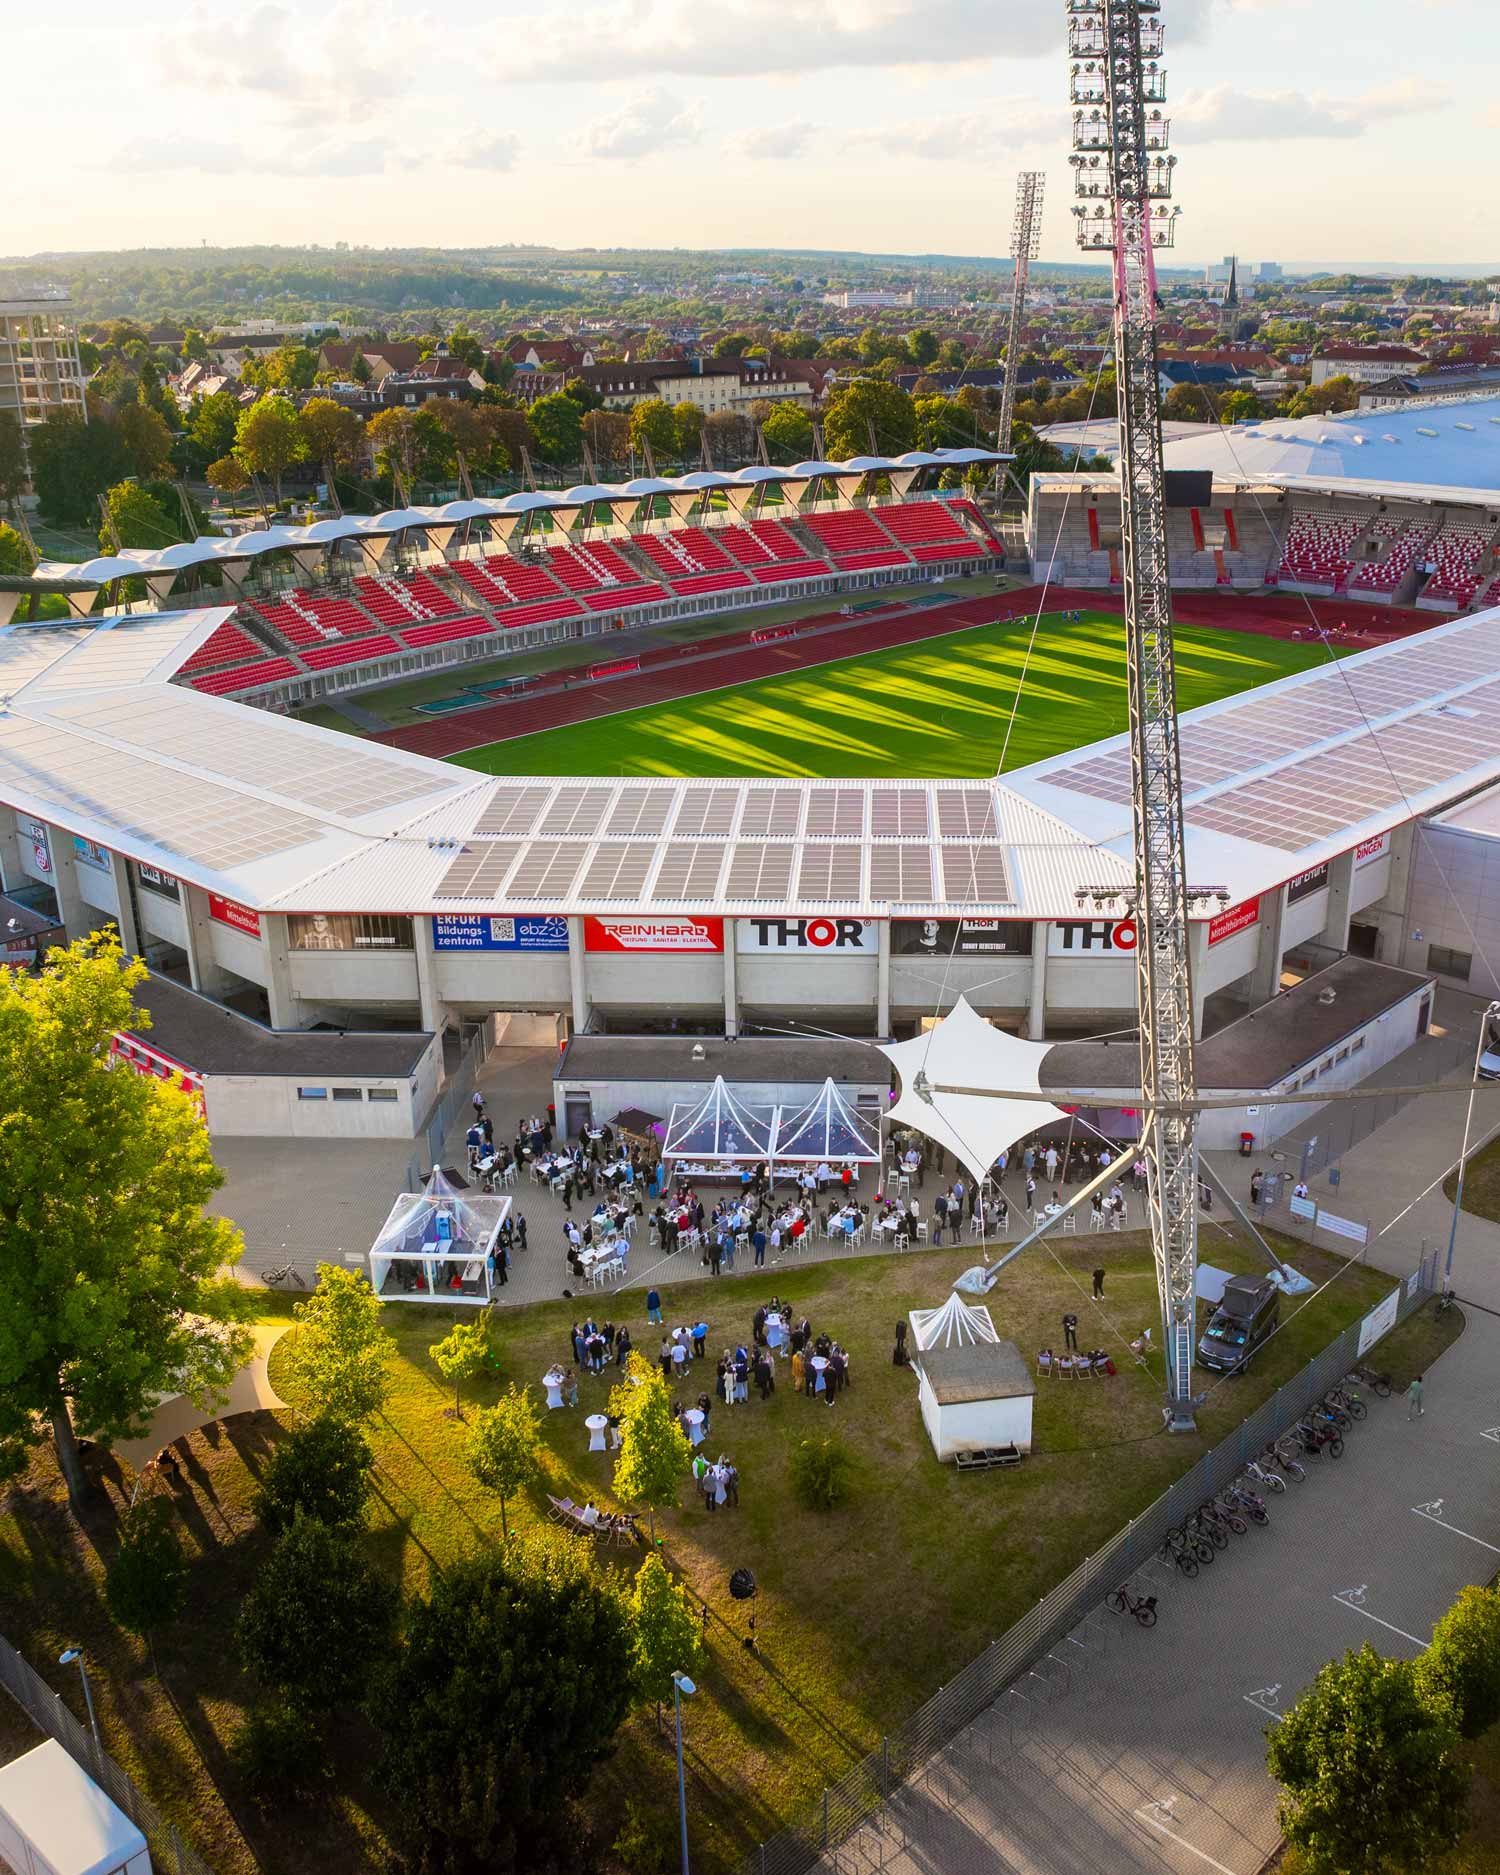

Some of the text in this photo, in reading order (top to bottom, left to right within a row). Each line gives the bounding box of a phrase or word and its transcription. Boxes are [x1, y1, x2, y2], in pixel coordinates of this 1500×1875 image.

[1357, 838, 1383, 861] RINGEN
[437, 915, 481, 925] ERFURT
[966, 920, 994, 928] THOR
[437, 926, 486, 937] Bildungs-
[519, 922, 549, 936] ebz
[1056, 920, 1138, 950] THO
[438, 937, 483, 945] zentrum
